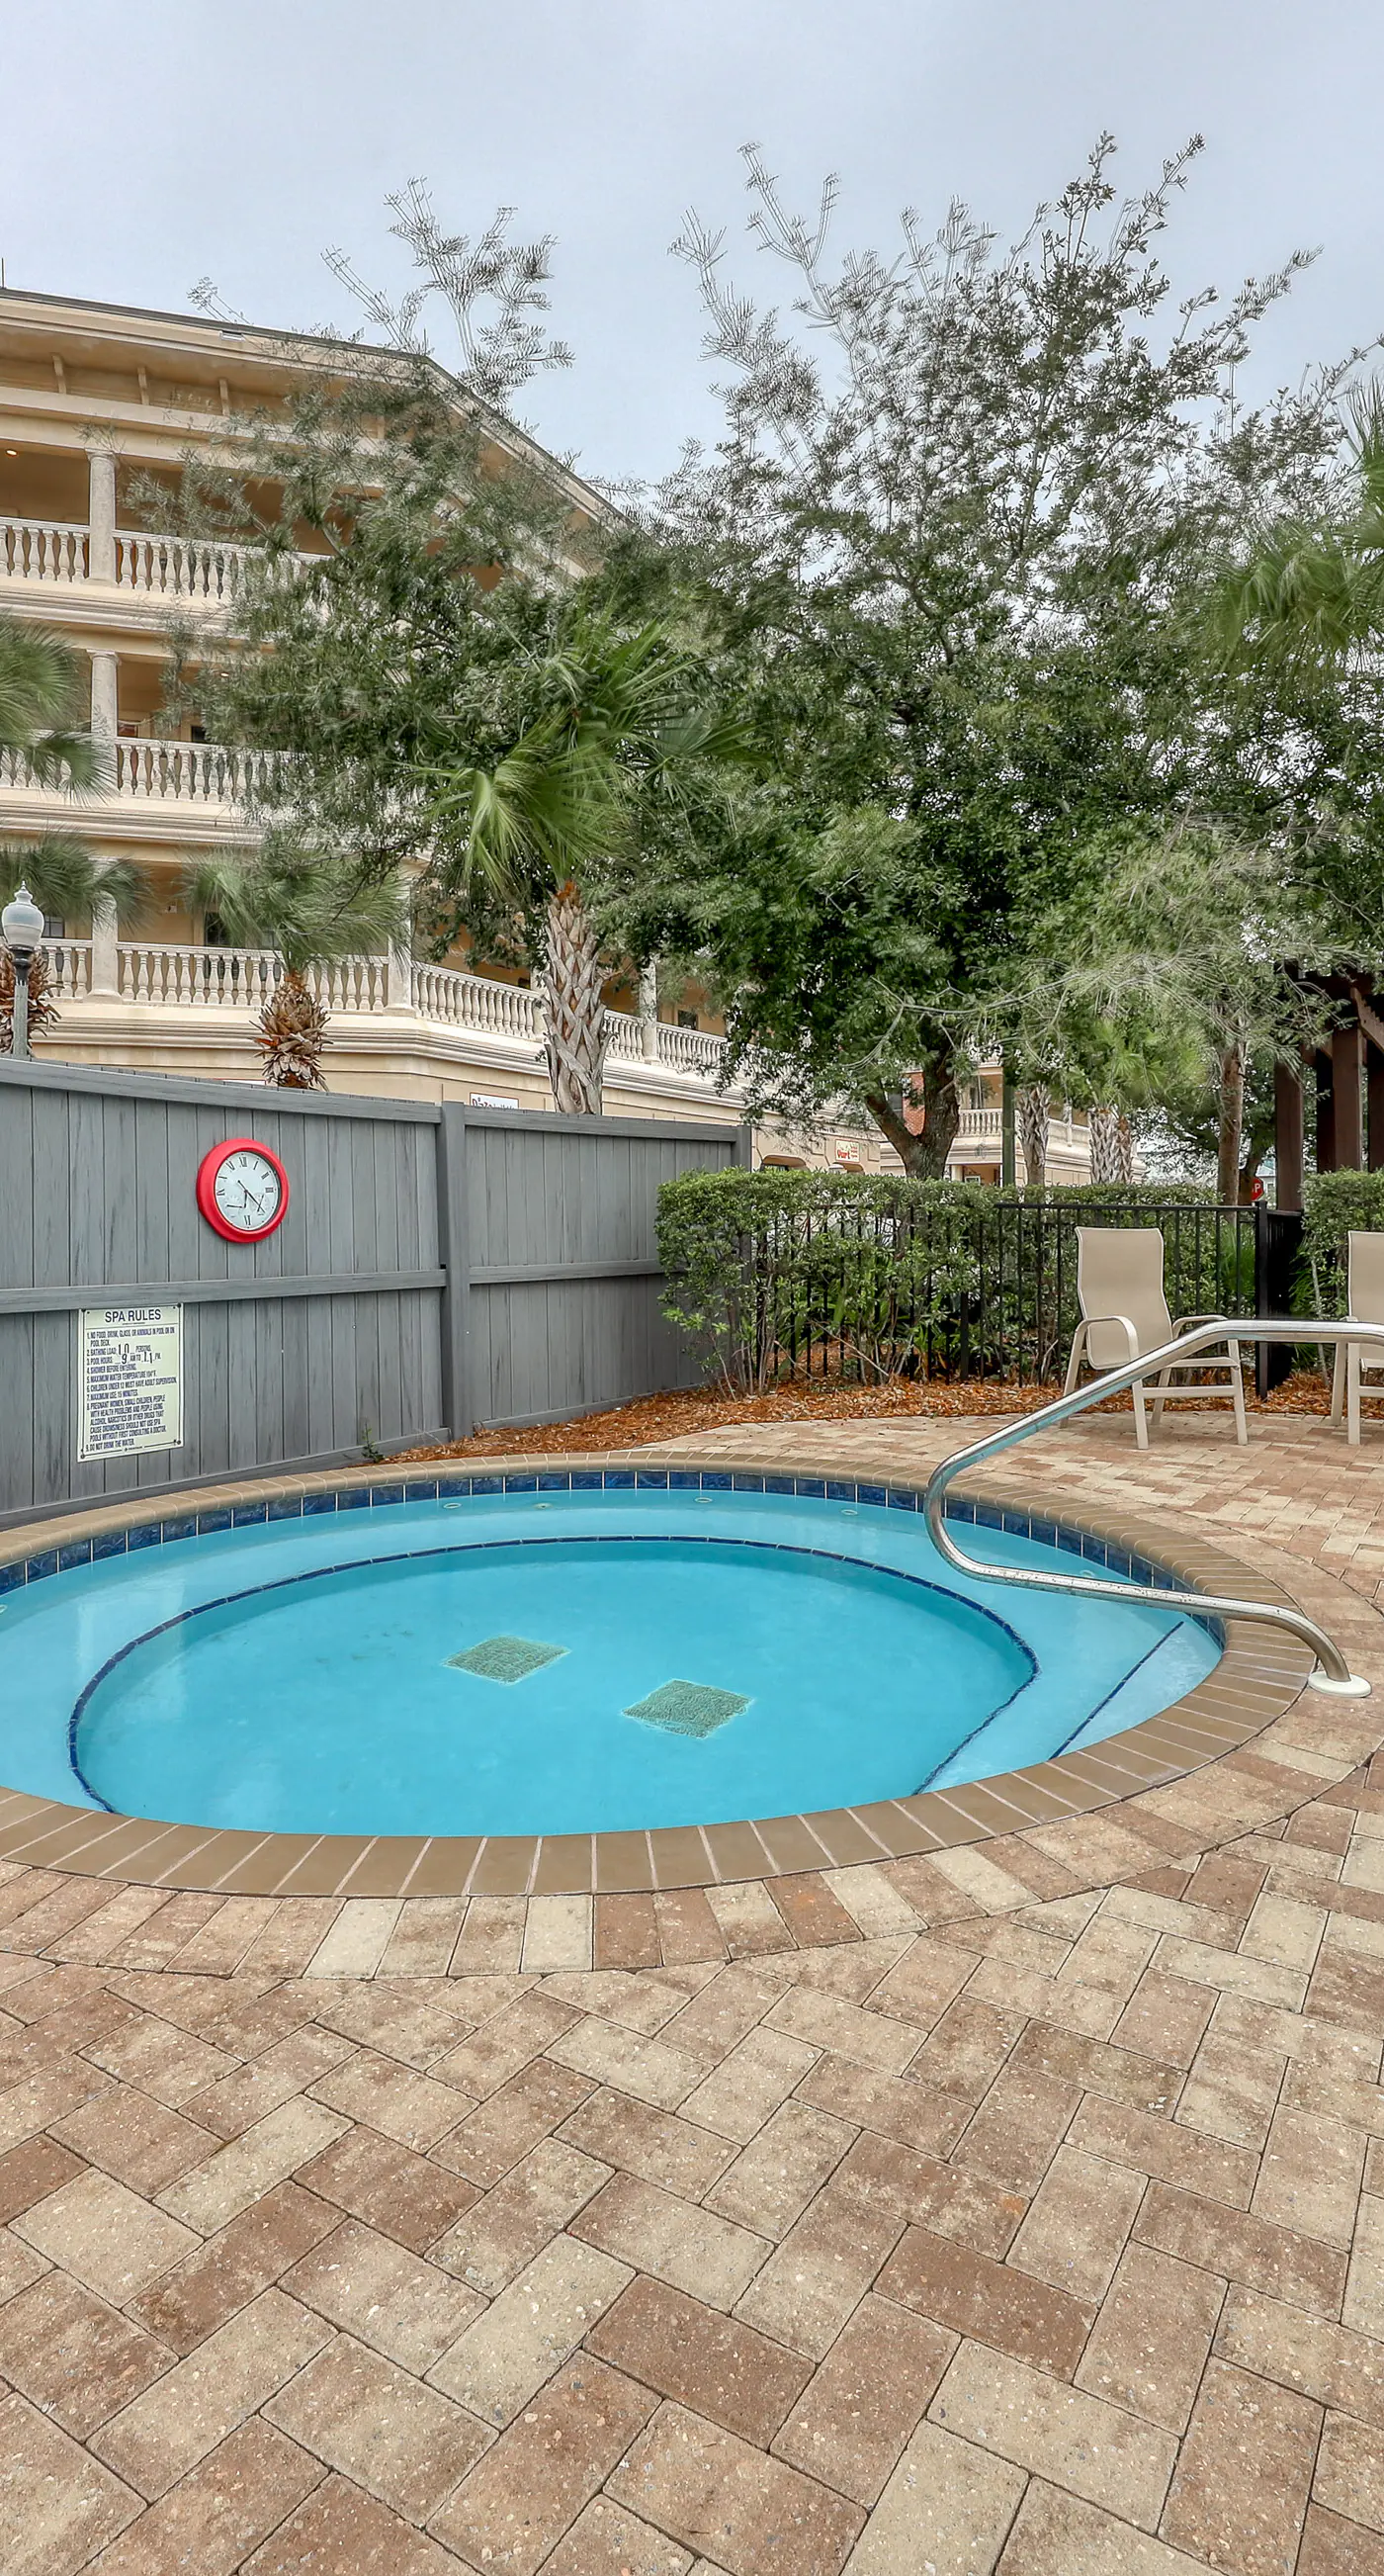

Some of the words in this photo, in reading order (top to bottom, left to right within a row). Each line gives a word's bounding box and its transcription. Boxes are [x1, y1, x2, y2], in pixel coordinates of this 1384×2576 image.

[105, 1311, 125, 1322] SPA
[128, 1309, 161, 1321] RULES
[119, 1344, 129, 1355] 10
[122, 1354, 128, 1364] 9
[123, 1371, 145, 1379] TEMPERATURE
[103, 1423, 125, 1432] DROWSINESS
[130, 1428, 149, 1437] CONSULTING
